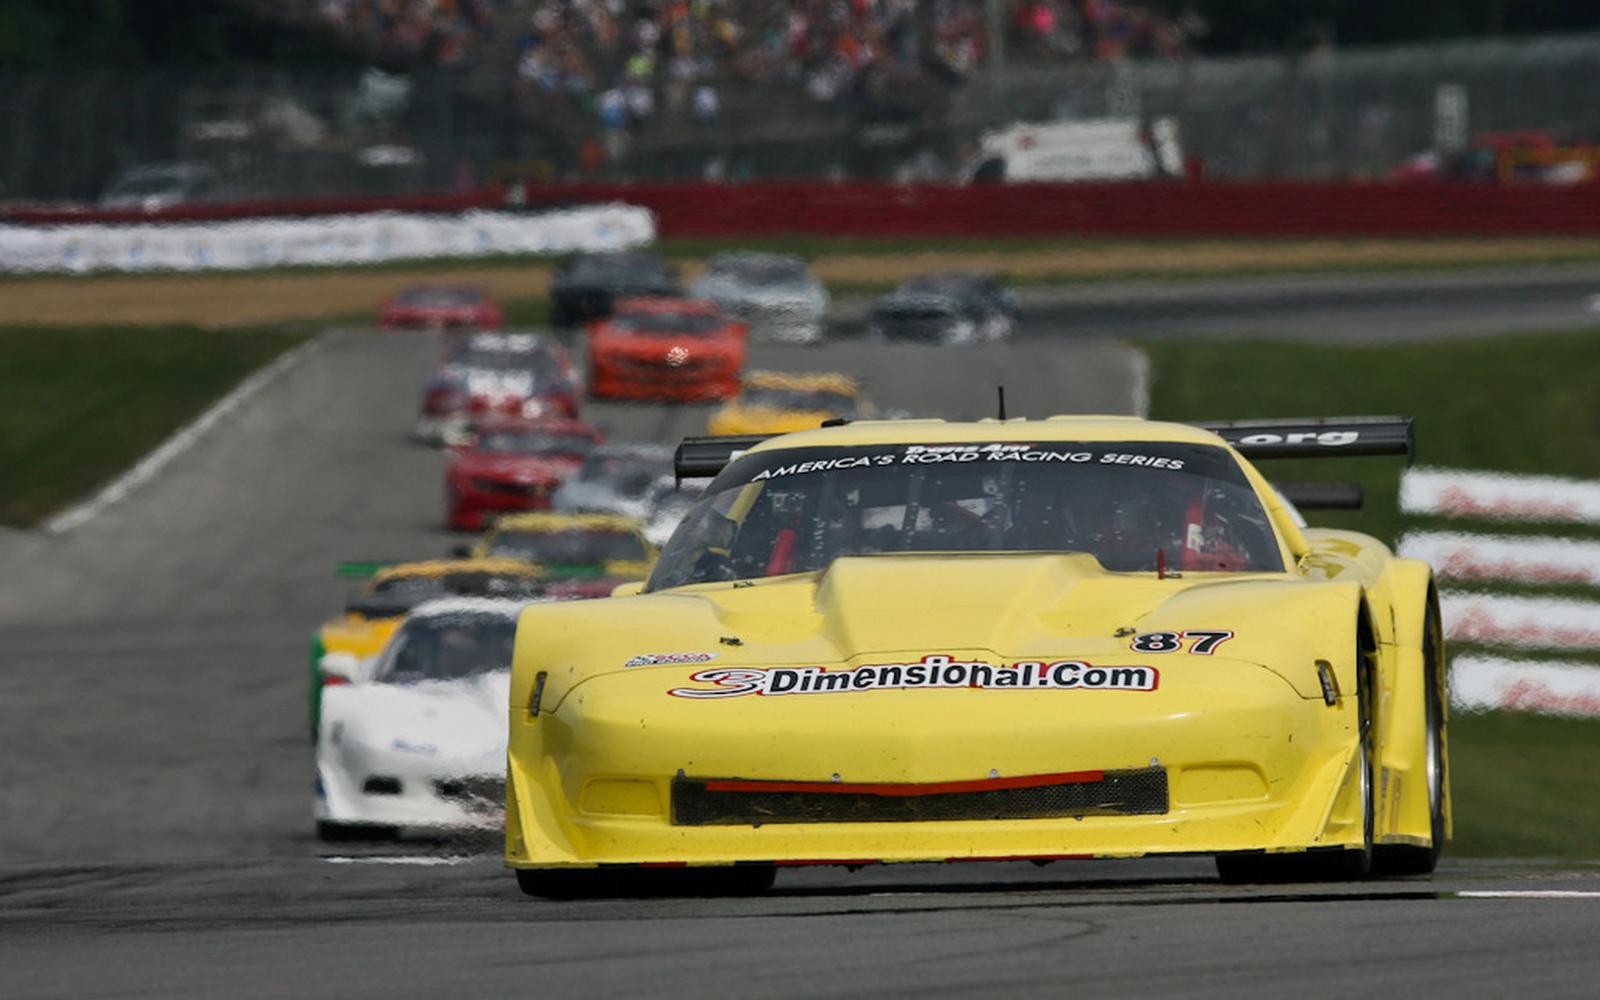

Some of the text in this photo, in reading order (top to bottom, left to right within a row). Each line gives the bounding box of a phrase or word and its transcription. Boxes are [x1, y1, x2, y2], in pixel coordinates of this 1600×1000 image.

[751, 454, 896, 482] AMERICA'S
[902, 451, 980, 464] ROAD
[986, 450, 1093, 463] RACING
[1100, 453, 1185, 470] SERIES
[1131, 630, 1234, 655] 87
